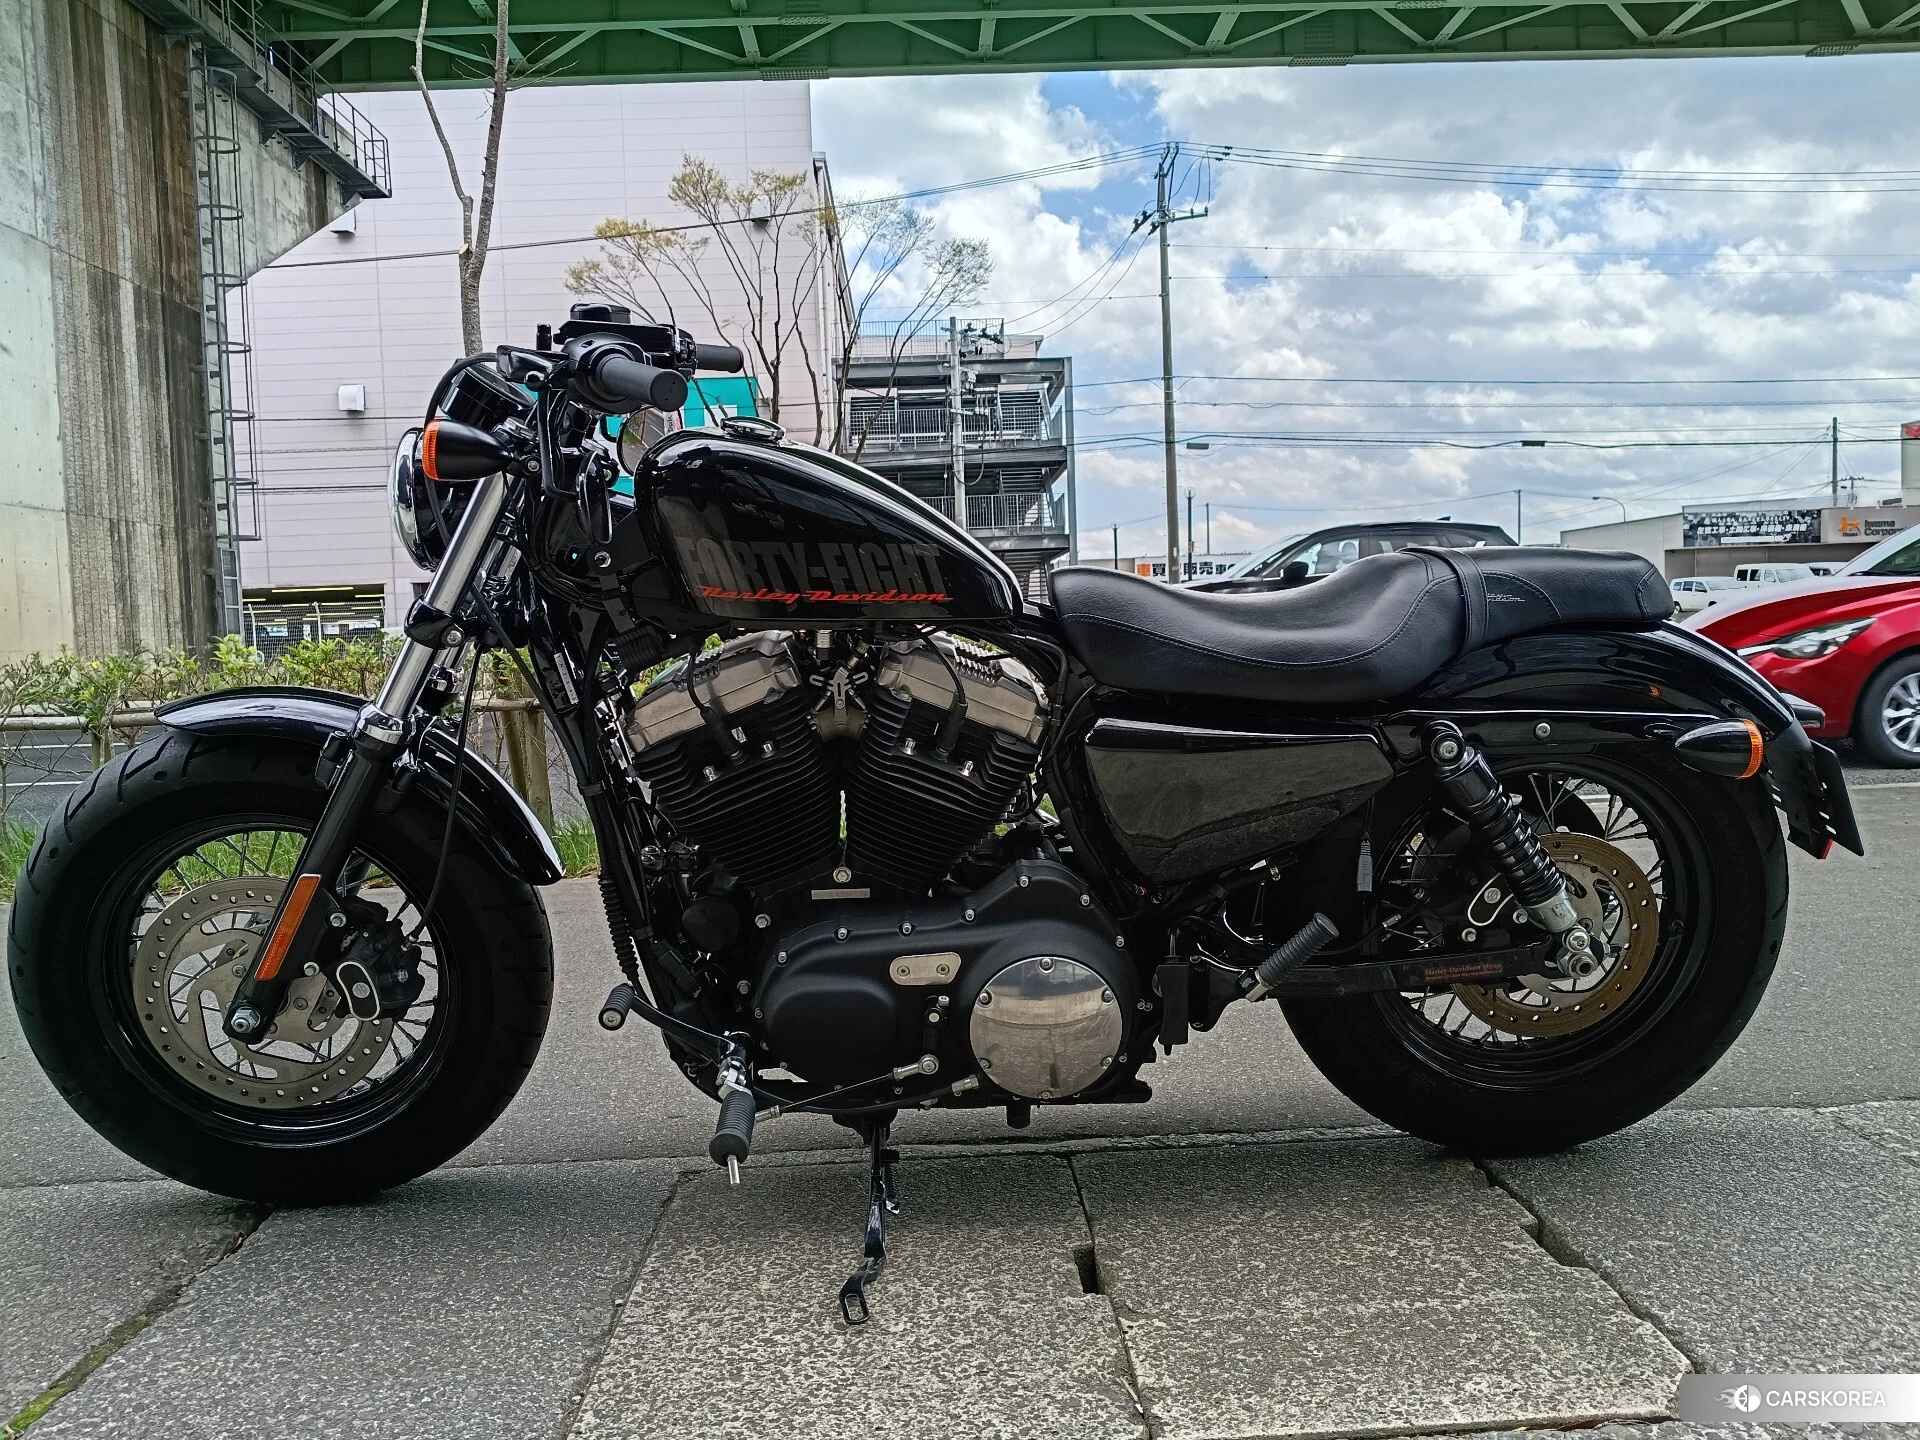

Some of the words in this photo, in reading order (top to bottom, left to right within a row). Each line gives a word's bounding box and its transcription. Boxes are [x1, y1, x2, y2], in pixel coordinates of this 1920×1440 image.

[675, 537, 948, 603] FORTY-EIGHT
[698, 585, 953, 604] Harley-Davidson
[1425, 965, 1480, 976] Harley-Davidson
